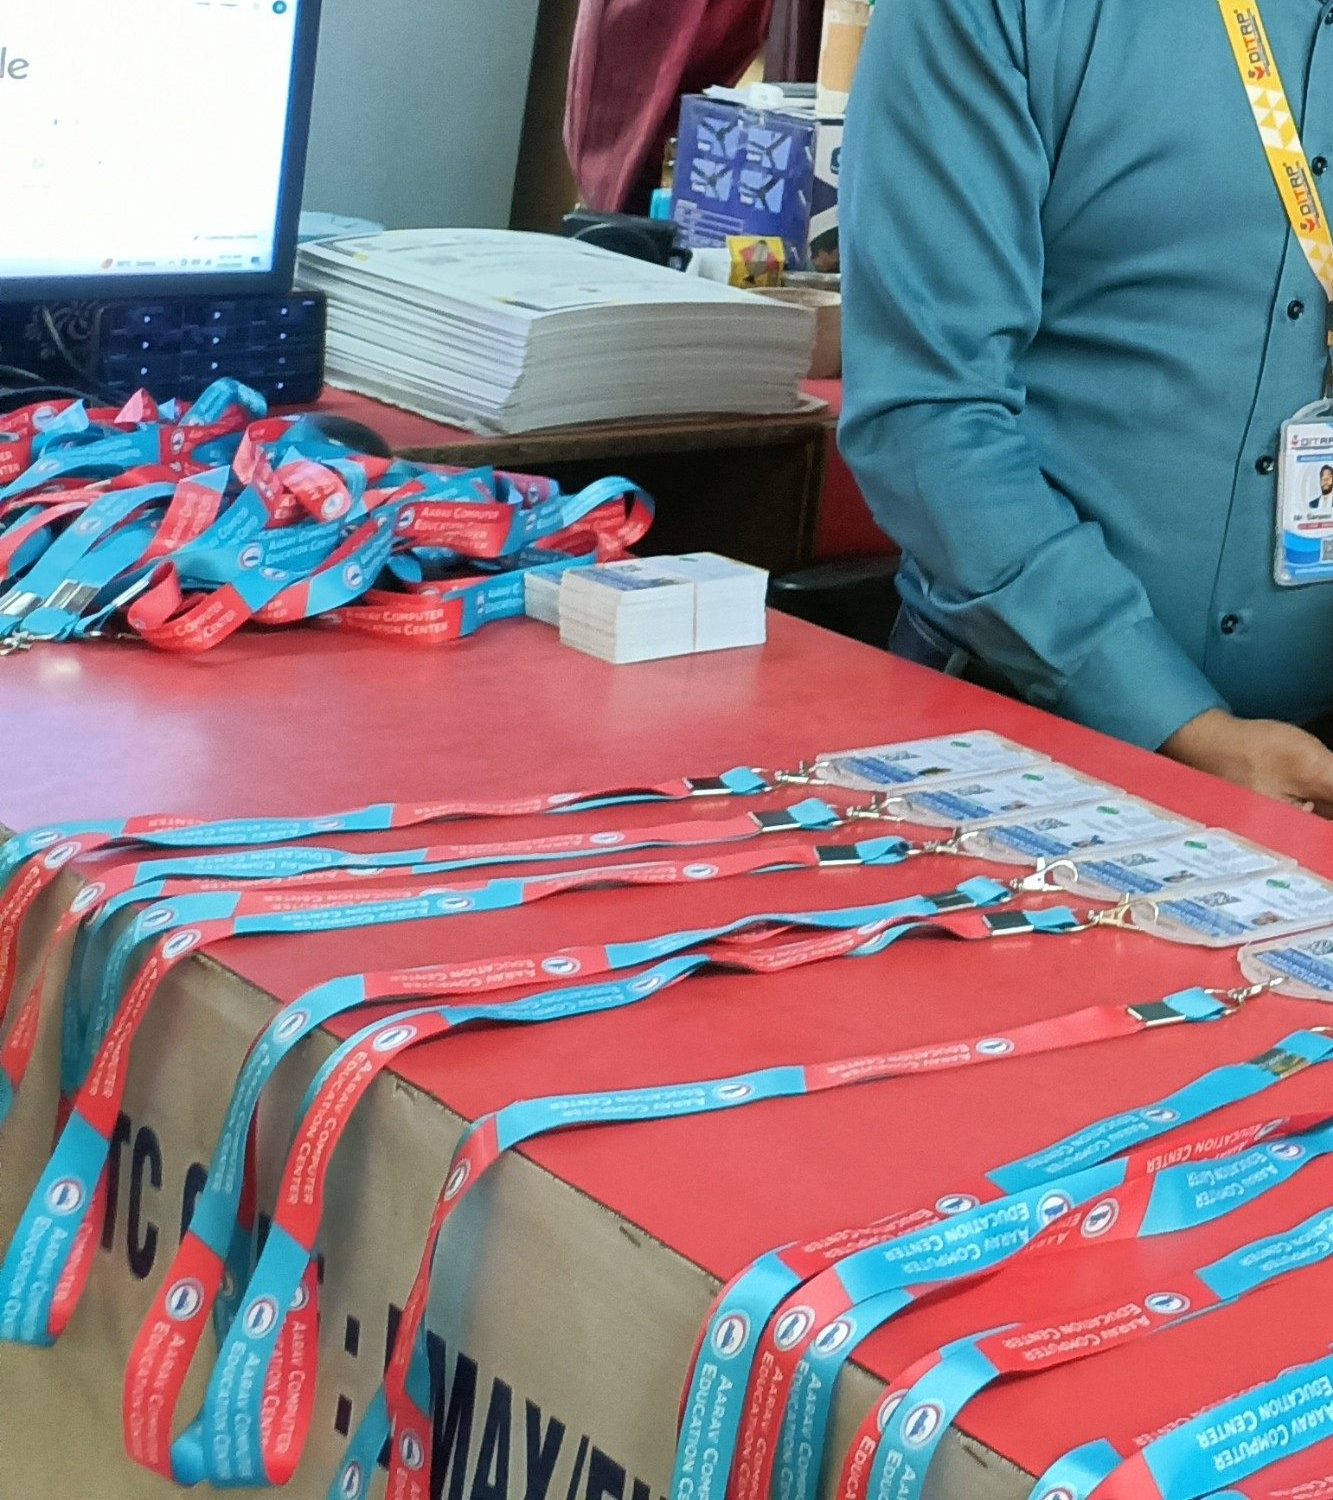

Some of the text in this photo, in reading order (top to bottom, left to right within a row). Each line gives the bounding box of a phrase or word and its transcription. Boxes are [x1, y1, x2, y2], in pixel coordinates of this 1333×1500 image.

[1146, 1147, 1194, 1174] CENTER
[884, 1203, 1031, 1263] EDUCATION CENTER
[903, 1225, 1032, 1277] AARAV COMPUTER
[1002, 1302, 1142, 1351] EDUCATION CENTER
[1024, 1333, 1101, 1363] COMPUTER
[681, 1364, 715, 1473] EDUCATION
[707, 1376, 735, 1444] AARAV
[1196, 1412, 1260, 1450] CENTER
[1212, 1428, 1290, 1471] COMPUTER
